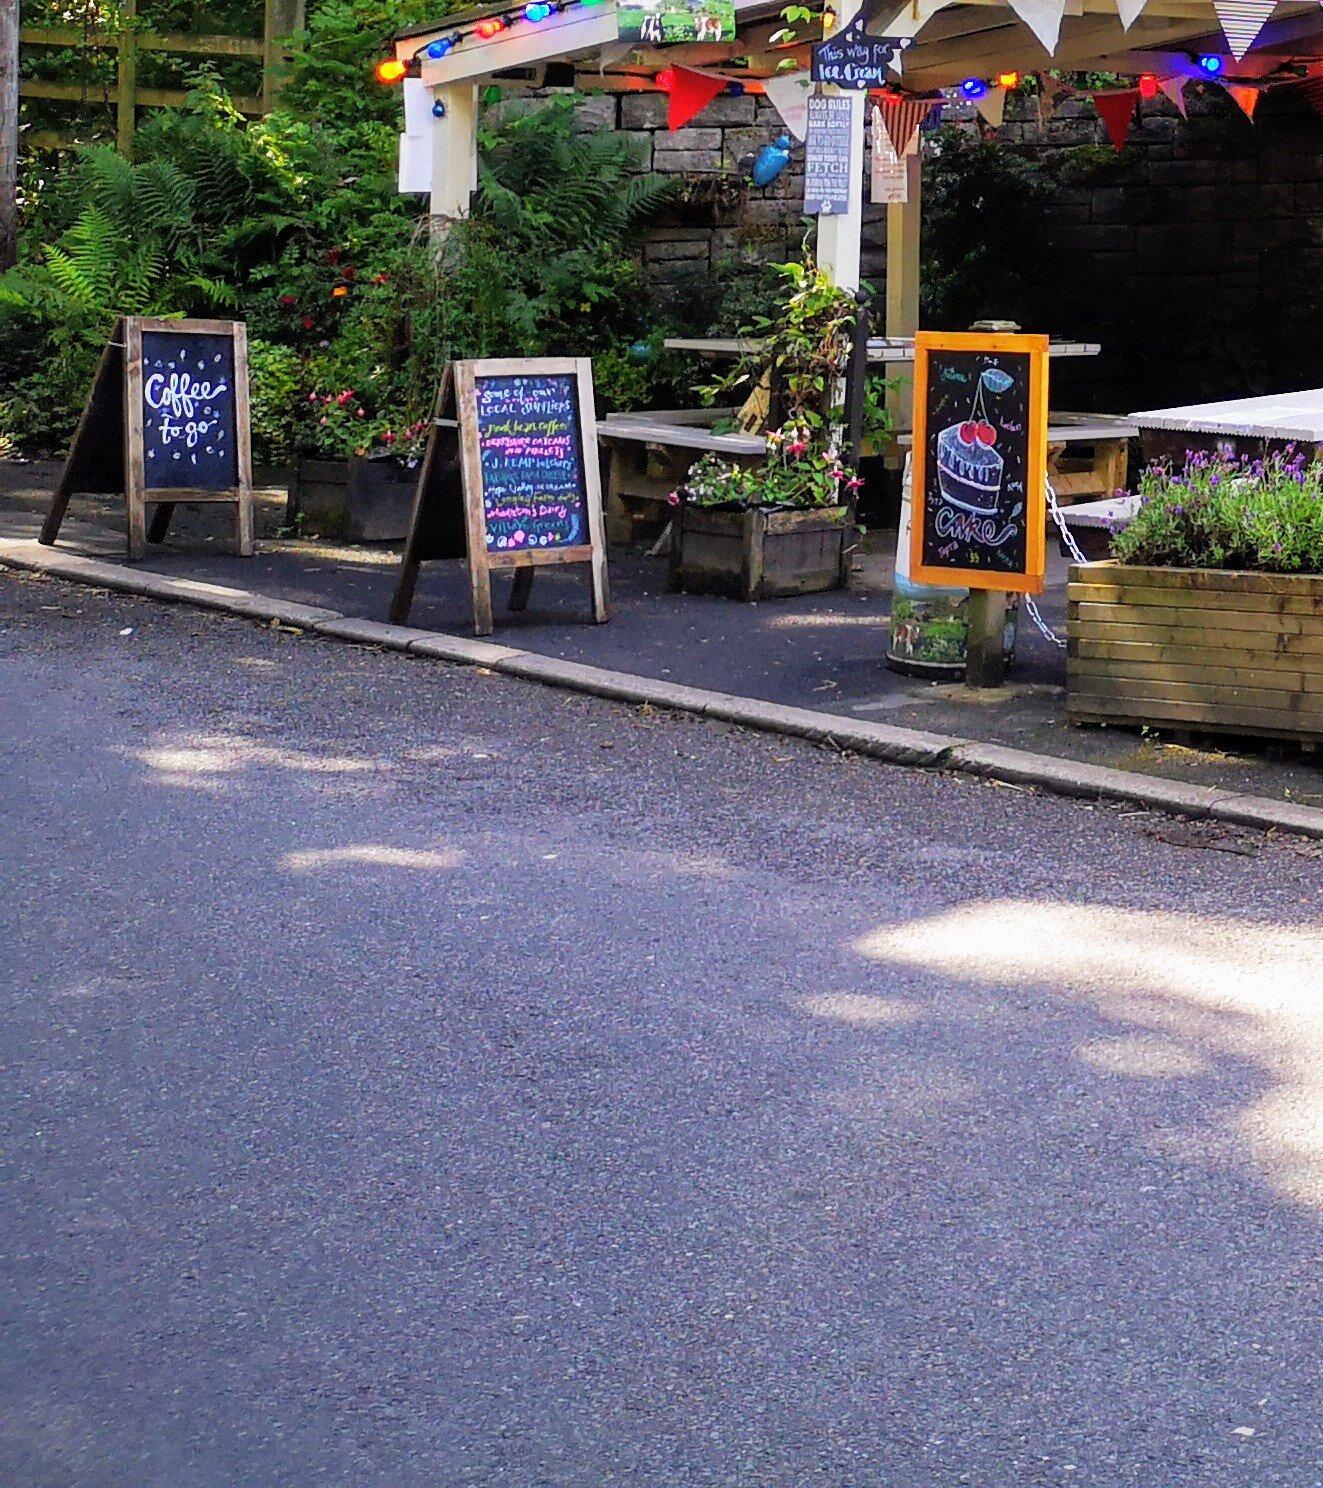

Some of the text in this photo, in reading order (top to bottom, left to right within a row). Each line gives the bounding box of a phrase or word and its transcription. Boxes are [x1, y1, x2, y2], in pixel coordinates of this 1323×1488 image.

[818, 43, 890, 65] This way for
[844, 62, 886, 85] Cream
[808, 98, 827, 110] DOG
[805, 162, 849, 173] FETCH
[144, 373, 227, 418] Coffee
[158, 417, 218, 448] to go
